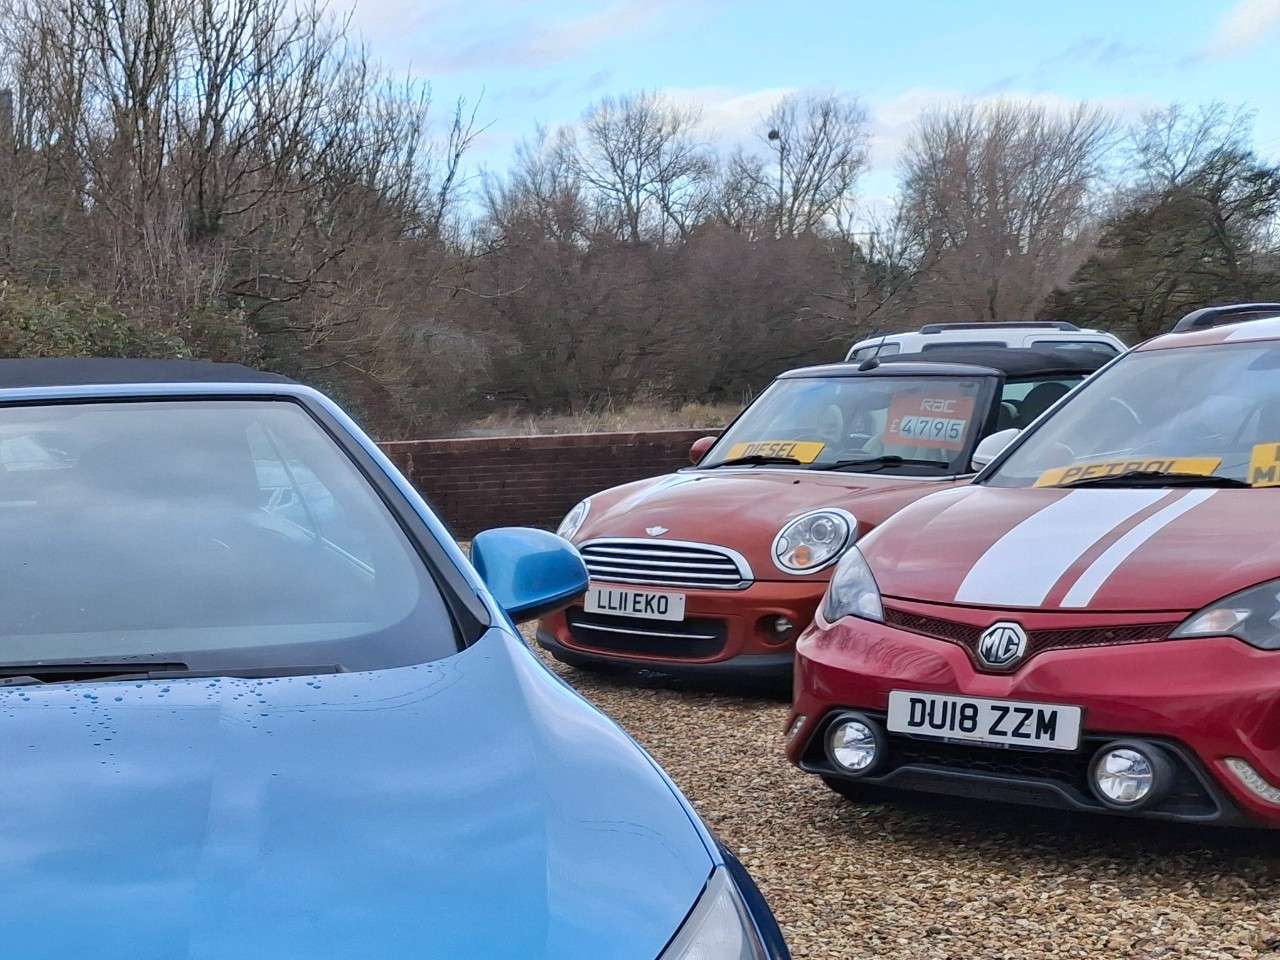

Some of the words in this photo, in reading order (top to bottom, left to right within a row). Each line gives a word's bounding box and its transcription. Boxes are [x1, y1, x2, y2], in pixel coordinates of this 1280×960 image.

[742, 443, 798, 458] DIESEL
[632, 593, 669, 615] EKO
[982, 627, 1019, 663] MG
[907, 698, 979, 733] DU18
[988, 705, 1058, 741] ZZM
